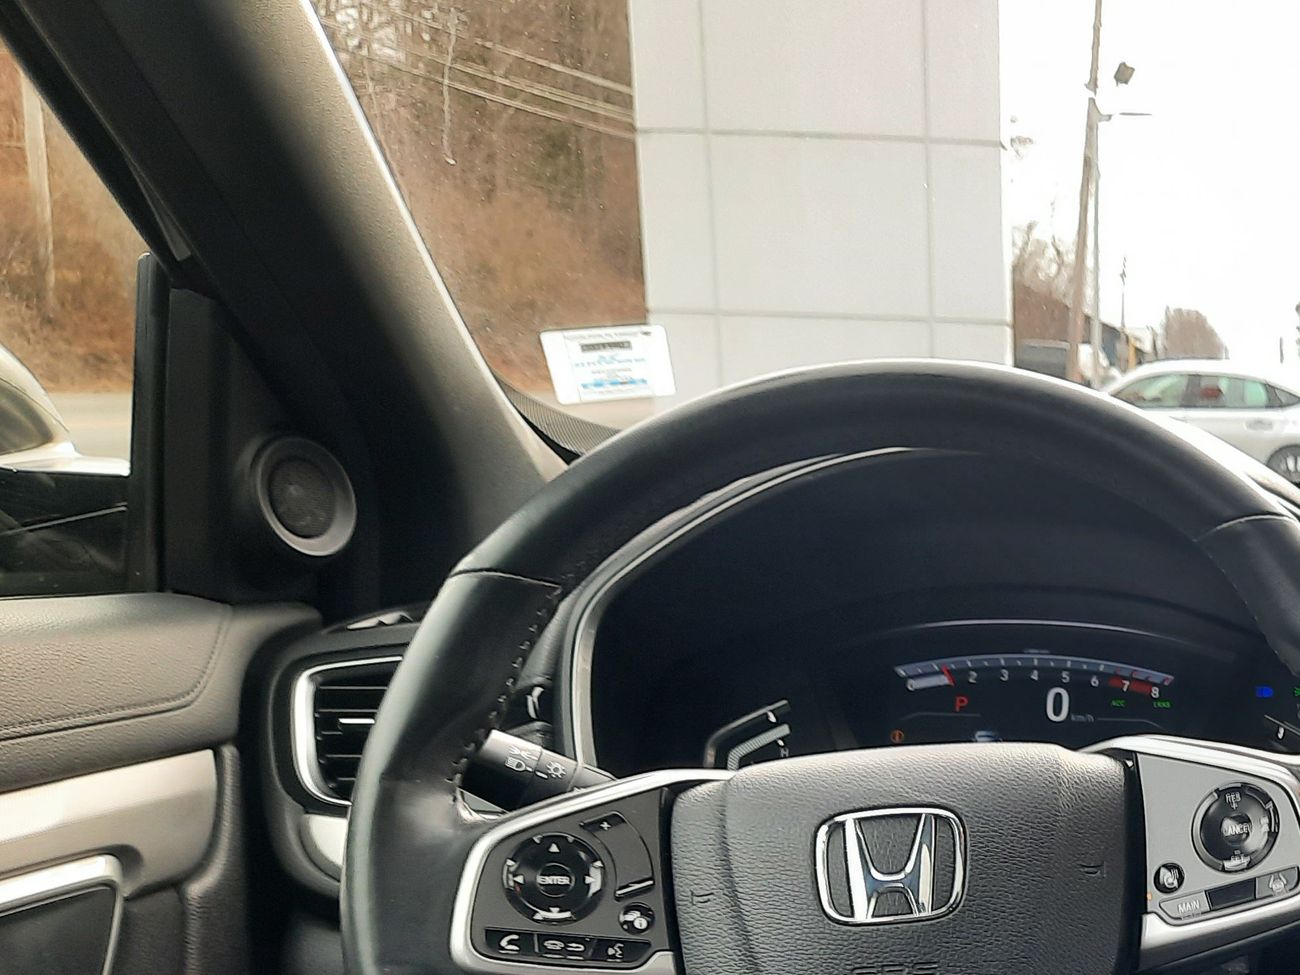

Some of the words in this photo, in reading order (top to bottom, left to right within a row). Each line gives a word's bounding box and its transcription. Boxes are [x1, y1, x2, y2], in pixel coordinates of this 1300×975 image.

[968, 671, 977, 683] 2
[1001, 669, 1009, 681] 3
[1030, 670, 1039, 681] 4
[1061, 671, 1070, 683] 5
[1090, 676, 1099, 687] 6
[1121, 680, 1130, 692] 7
[1151, 687, 1160, 698] 8
[955, 696, 969, 712] P
[1046, 687, 1070, 722] 0
[538, 875, 570, 886] ENTER
[1177, 900, 1200, 913] MAIN
